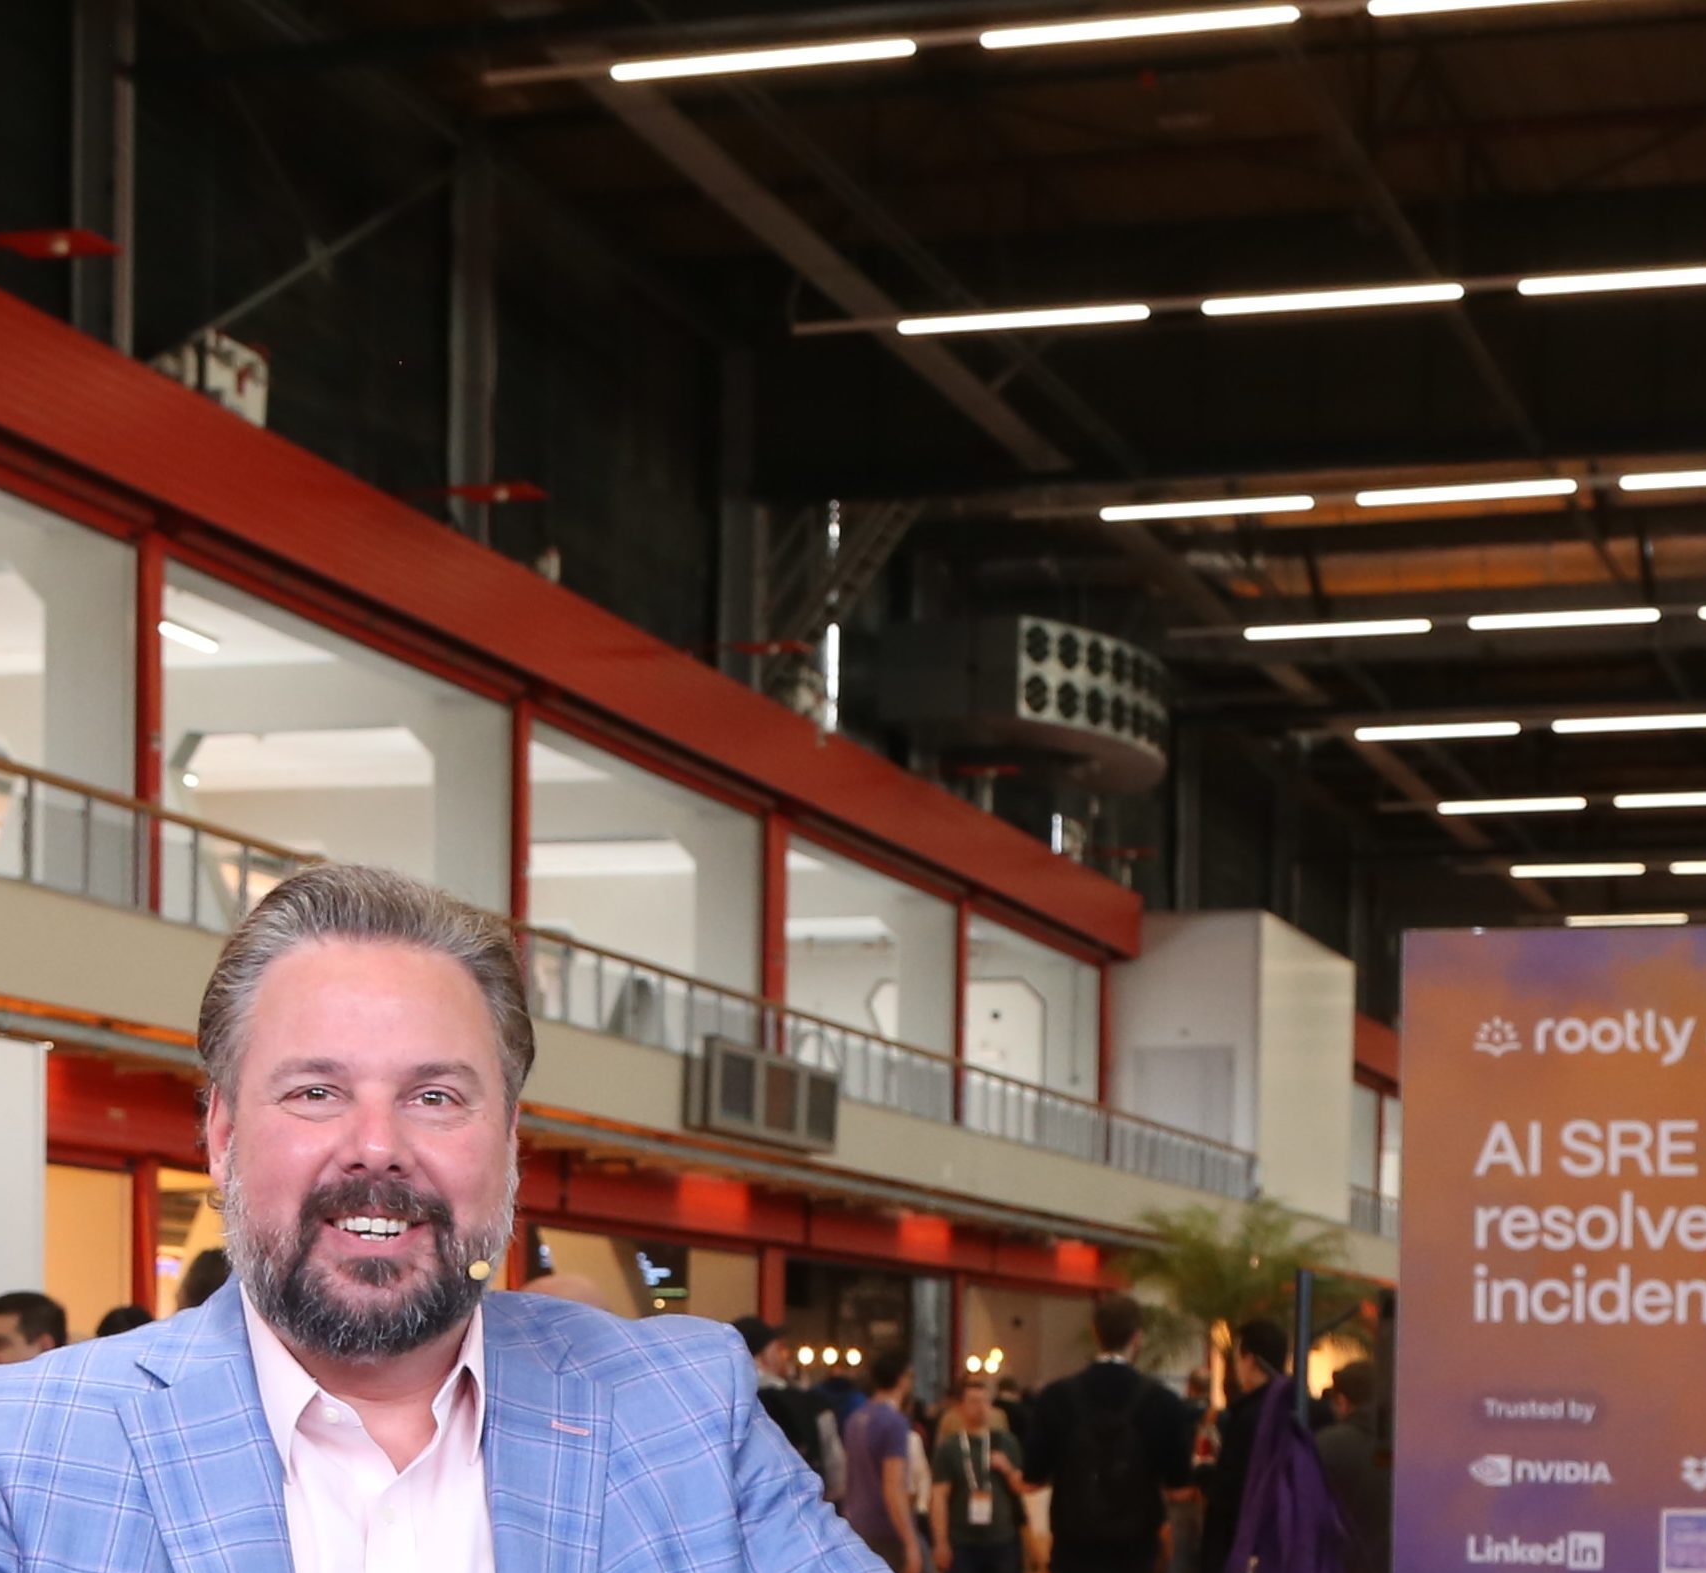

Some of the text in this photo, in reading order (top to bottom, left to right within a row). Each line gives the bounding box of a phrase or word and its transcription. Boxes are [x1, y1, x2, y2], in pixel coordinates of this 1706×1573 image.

[1533, 1007, 1696, 1065] rootly
[1475, 1120, 1541, 1177] AI
[1559, 1119, 1696, 1178] SRE
[1484, 1397, 1597, 1424] Trusted by
